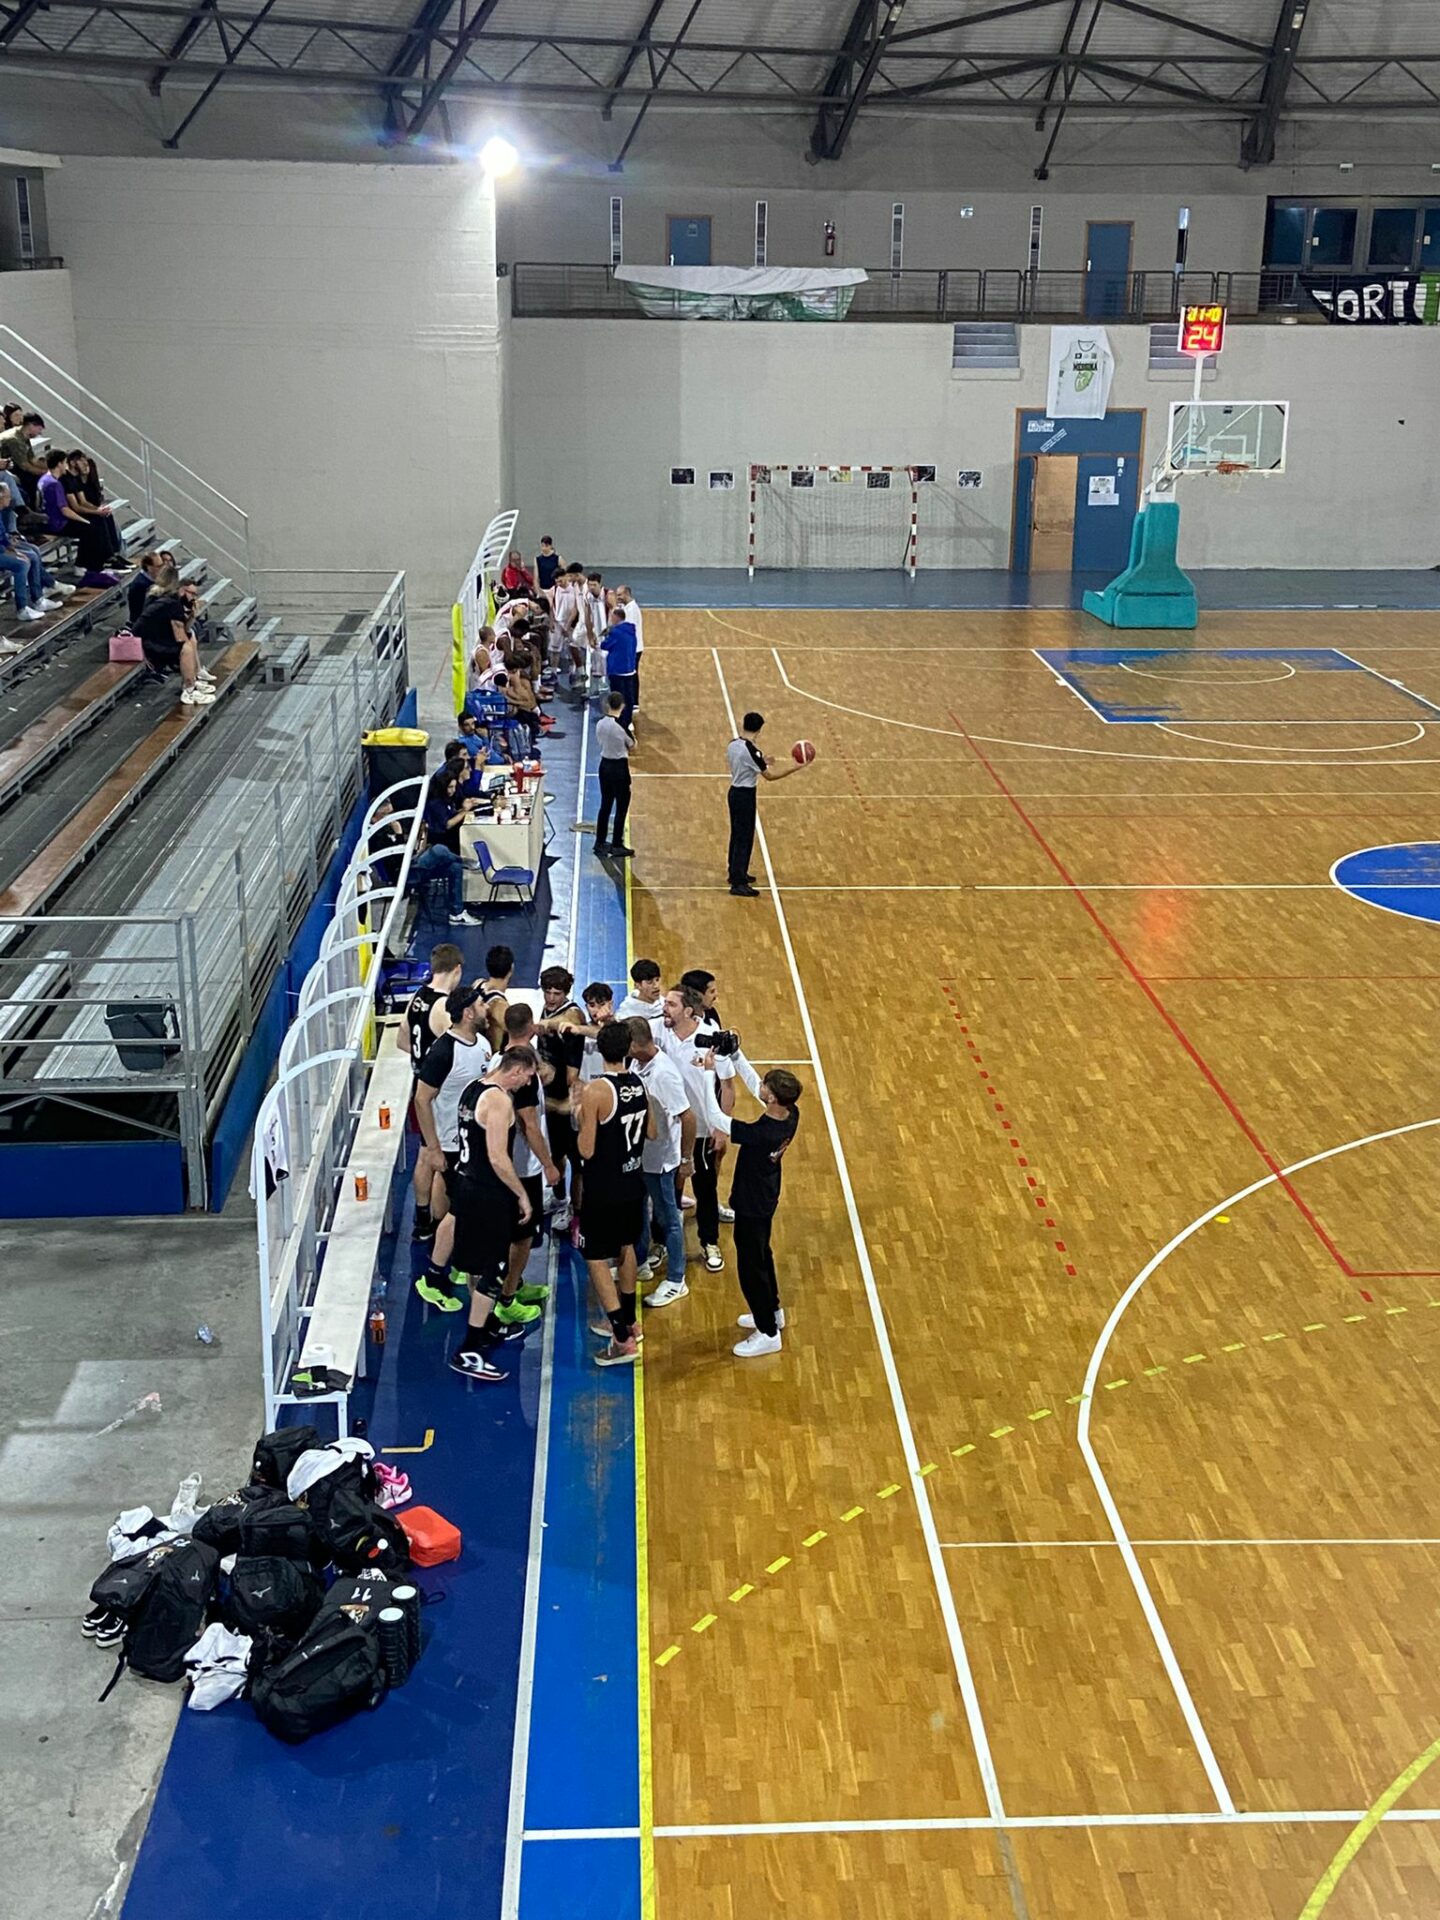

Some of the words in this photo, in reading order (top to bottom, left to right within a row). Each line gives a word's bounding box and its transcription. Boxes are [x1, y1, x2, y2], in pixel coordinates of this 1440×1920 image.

[1187, 326, 1219, 349] 24
[412, 1024, 422, 1059] 3
[620, 1109, 648, 1152] 77
